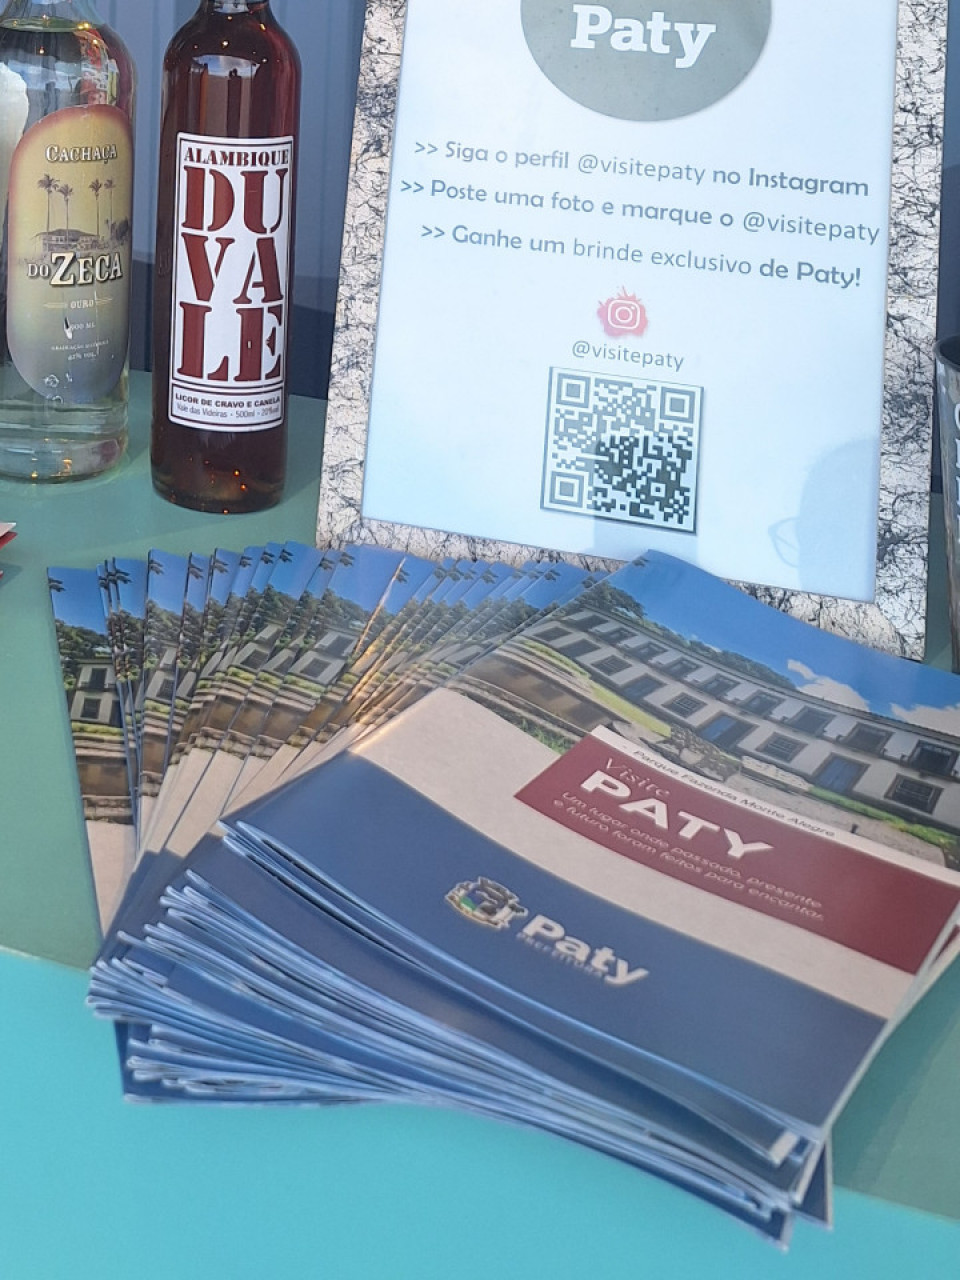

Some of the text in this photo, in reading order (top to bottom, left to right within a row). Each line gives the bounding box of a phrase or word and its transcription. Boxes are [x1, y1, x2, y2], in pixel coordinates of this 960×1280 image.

[569, 3, 717, 69] Paty
[45, 142, 118, 165] CACHAÇA
[183, 147, 290, 167] ALAMBIQUE
[444, 139, 489, 166] Siga
[494, 150, 509, 165] o
[514, 146, 570, 171] perfil
[577, 153, 706, 187] @visitepaty
[712, 168, 741, 185] no
[748, 167, 869, 198] Instagram
[181, 165, 289, 234] DU
[430, 179, 488, 204] Poste
[494, 191, 545, 210] uma
[550, 191, 595, 215] foto
[601, 201, 615, 216] e
[621, 202, 713, 232] marque
[720, 211, 734, 227] o
[742, 210, 880, 246] @visitepaty
[27, 250, 123, 286] DO ZECA
[180, 232, 285, 304] VA
[451, 224, 523, 251] Ganhe
[529, 238, 566, 256] um
[572, 238, 643, 264] brinde
[650, 248, 753, 276] exclusivo
[758, 258, 789, 280] de
[795, 260, 861, 290] Paty!
[176, 301, 283, 382] LE
[572, 340, 685, 372] @visitepaty
[175, 392, 281, 409] LICOR DE CRAVO E CANELA
[605, 757, 671, 797] Visite
[633, 749, 836, 838] Parque Fazenda Monte Alegre
[580, 769, 776, 859] PATY
[561, 791, 588, 810] Um
[588, 806, 630, 830] lugar
[630, 827, 670, 849] onde
[745, 876, 824, 909] presente
[566, 806, 610, 832] futuro
[611, 830, 658, 854] foram
[659, 851, 703, 874] feitos
[703, 871, 746, 891] para
[522, 914, 651, 986] Paty
